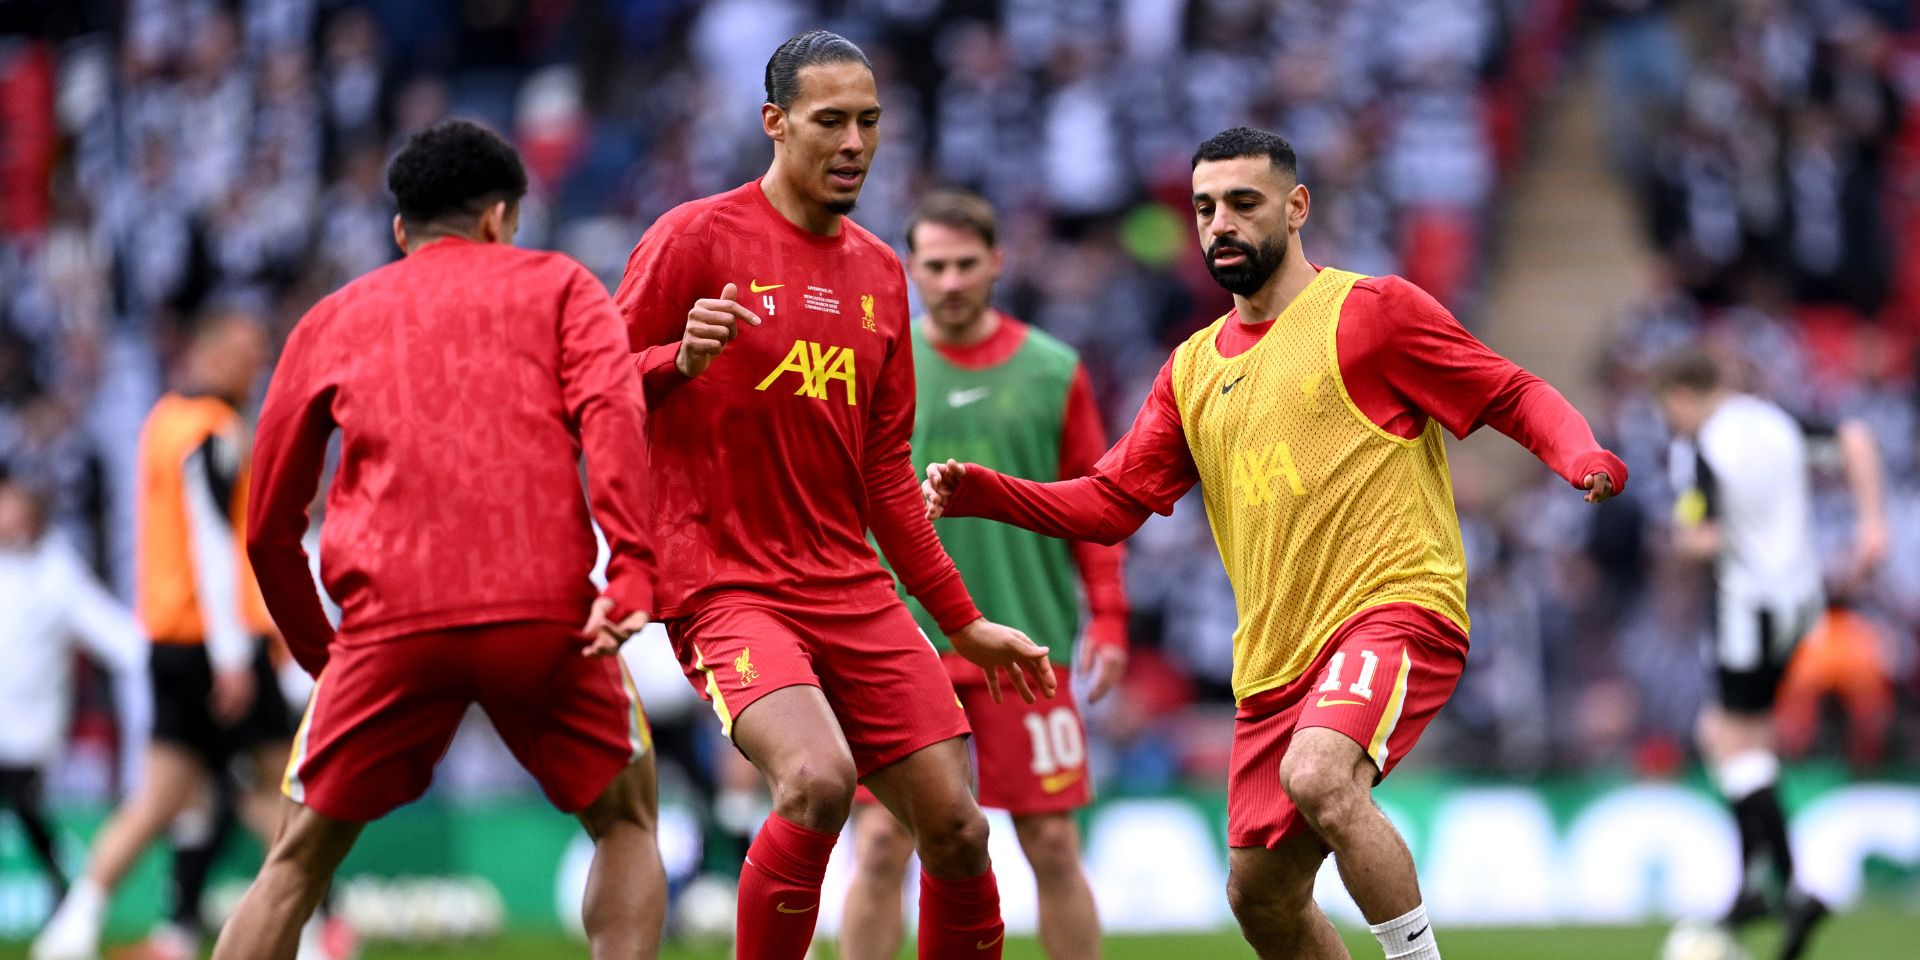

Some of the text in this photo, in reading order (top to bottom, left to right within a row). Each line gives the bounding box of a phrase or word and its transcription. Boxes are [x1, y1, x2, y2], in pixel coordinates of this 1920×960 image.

[762, 295, 775, 316] 4
[862, 319, 877, 332] LFC
[754, 339, 857, 406] AXA
[1231, 441, 1308, 508] AXA
[741, 671, 761, 687] LFC
[1318, 650, 1378, 701] 11
[1024, 708, 1083, 775] 10
